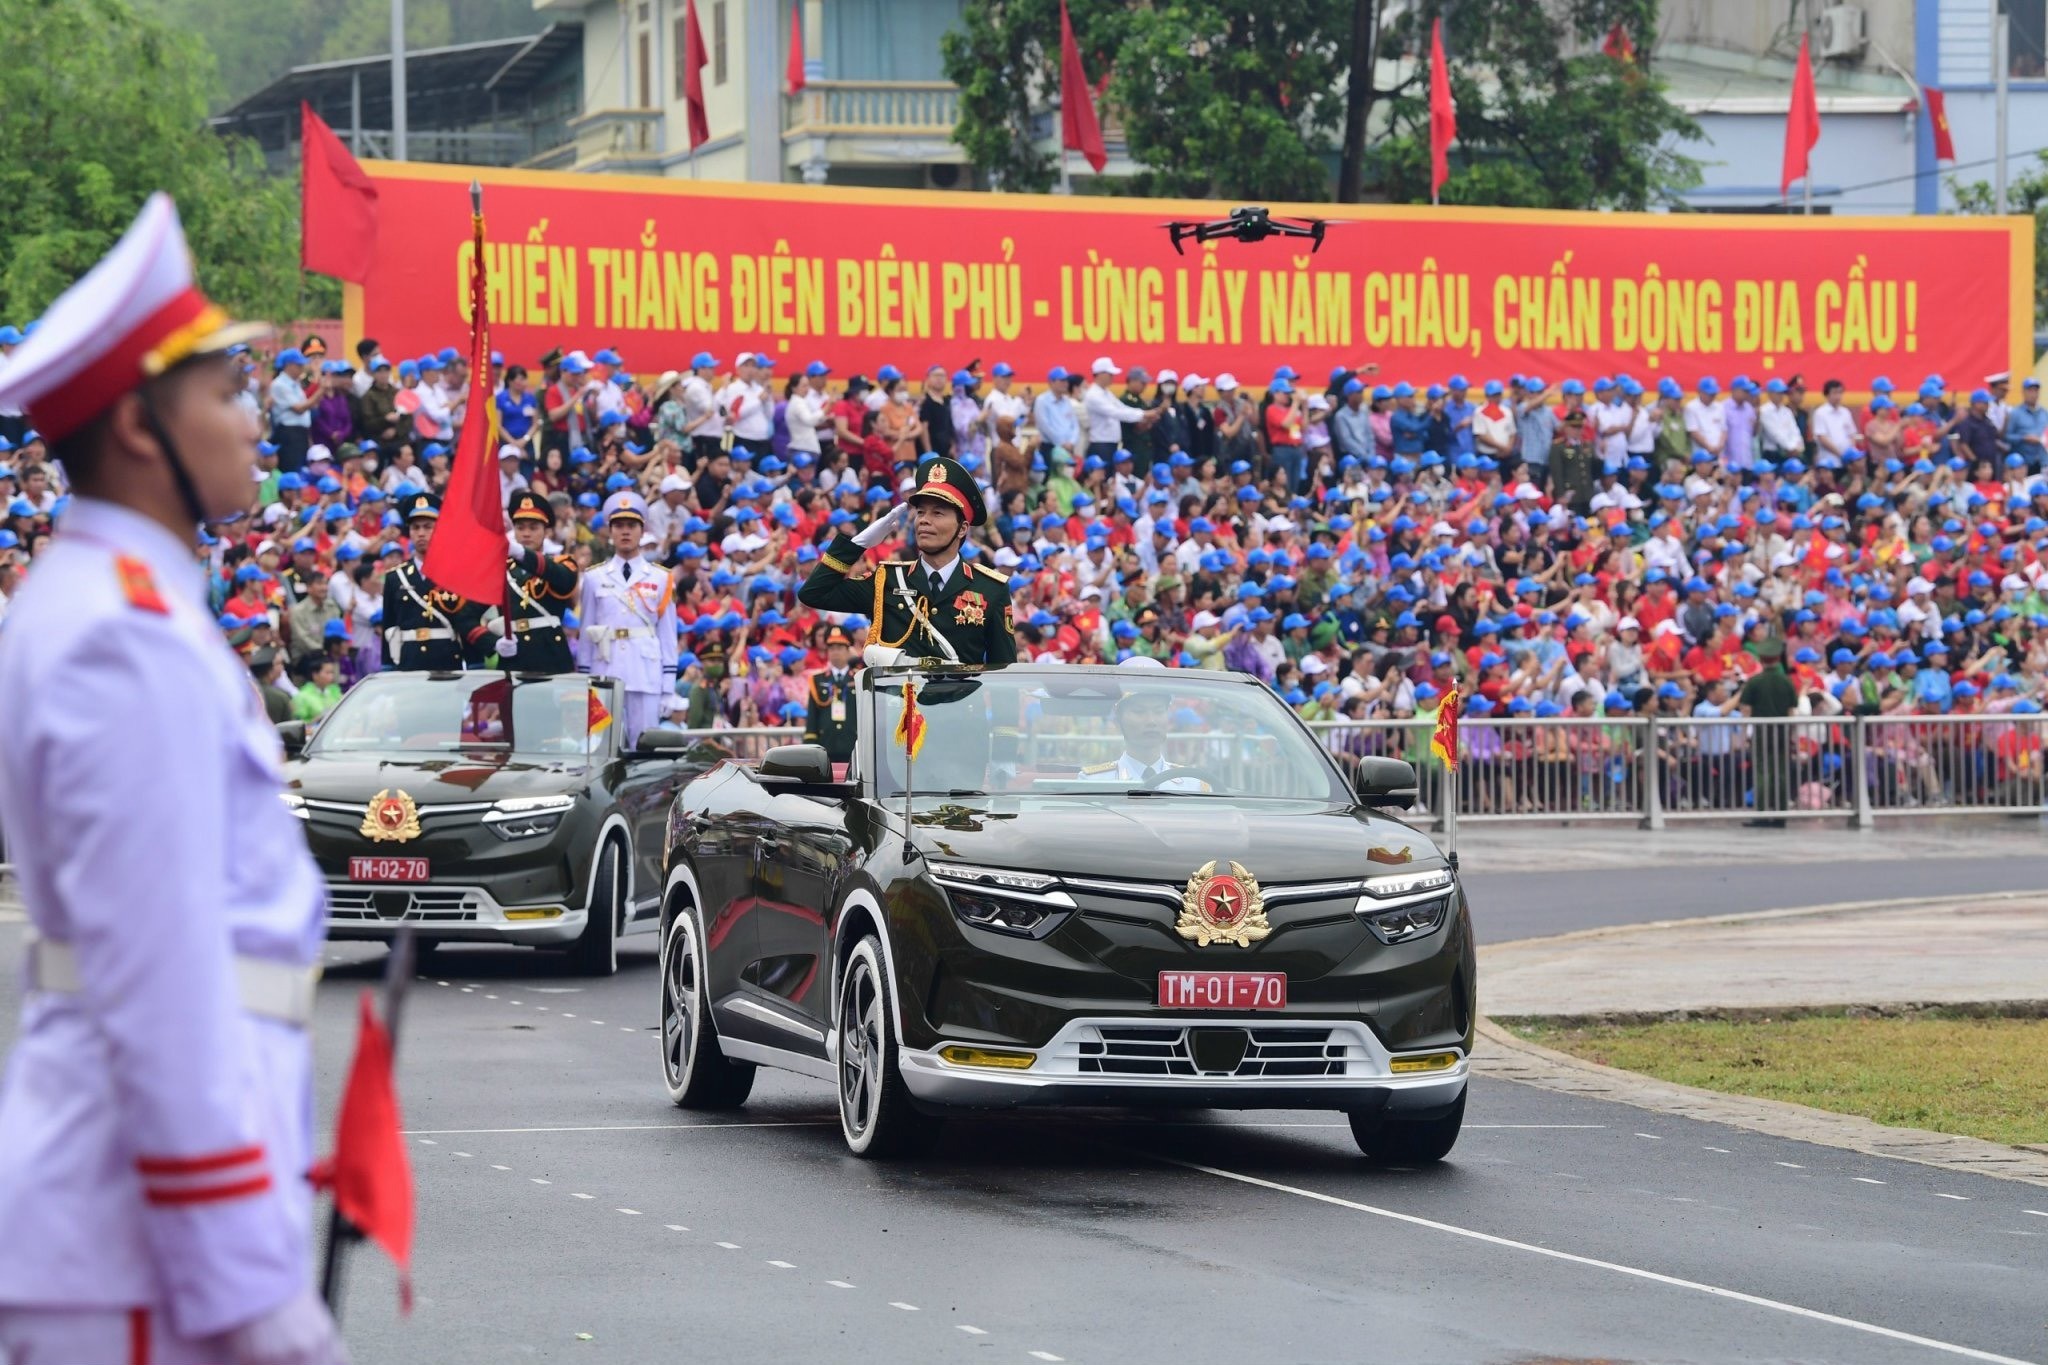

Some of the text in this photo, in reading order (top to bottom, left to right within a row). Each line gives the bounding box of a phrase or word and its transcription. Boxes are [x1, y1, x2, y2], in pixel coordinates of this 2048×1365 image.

[457, 217, 577, 327] CHIẾN
[588, 219, 720, 332] THẮNG
[730, 239, 825, 353] ĐIỆN
[837, 243, 931, 338] BIÊN
[942, 237, 1022, 341] PHỦ
[1034, 300, 1049, 317] -
[1061, 249, 1165, 344] LỪNG
[1259, 255, 1352, 346] NĂM
[1364, 257, 1481, 357] CHÂU,
[1493, 250, 1601, 351] CHẤN
[1611, 263, 1722, 368] ĐỘNG
[1733, 280, 1803, 369] ĐỊA
[352, 861, 426, 878] TM-02-70
[1164, 975, 1281, 1004] TM-01-70
